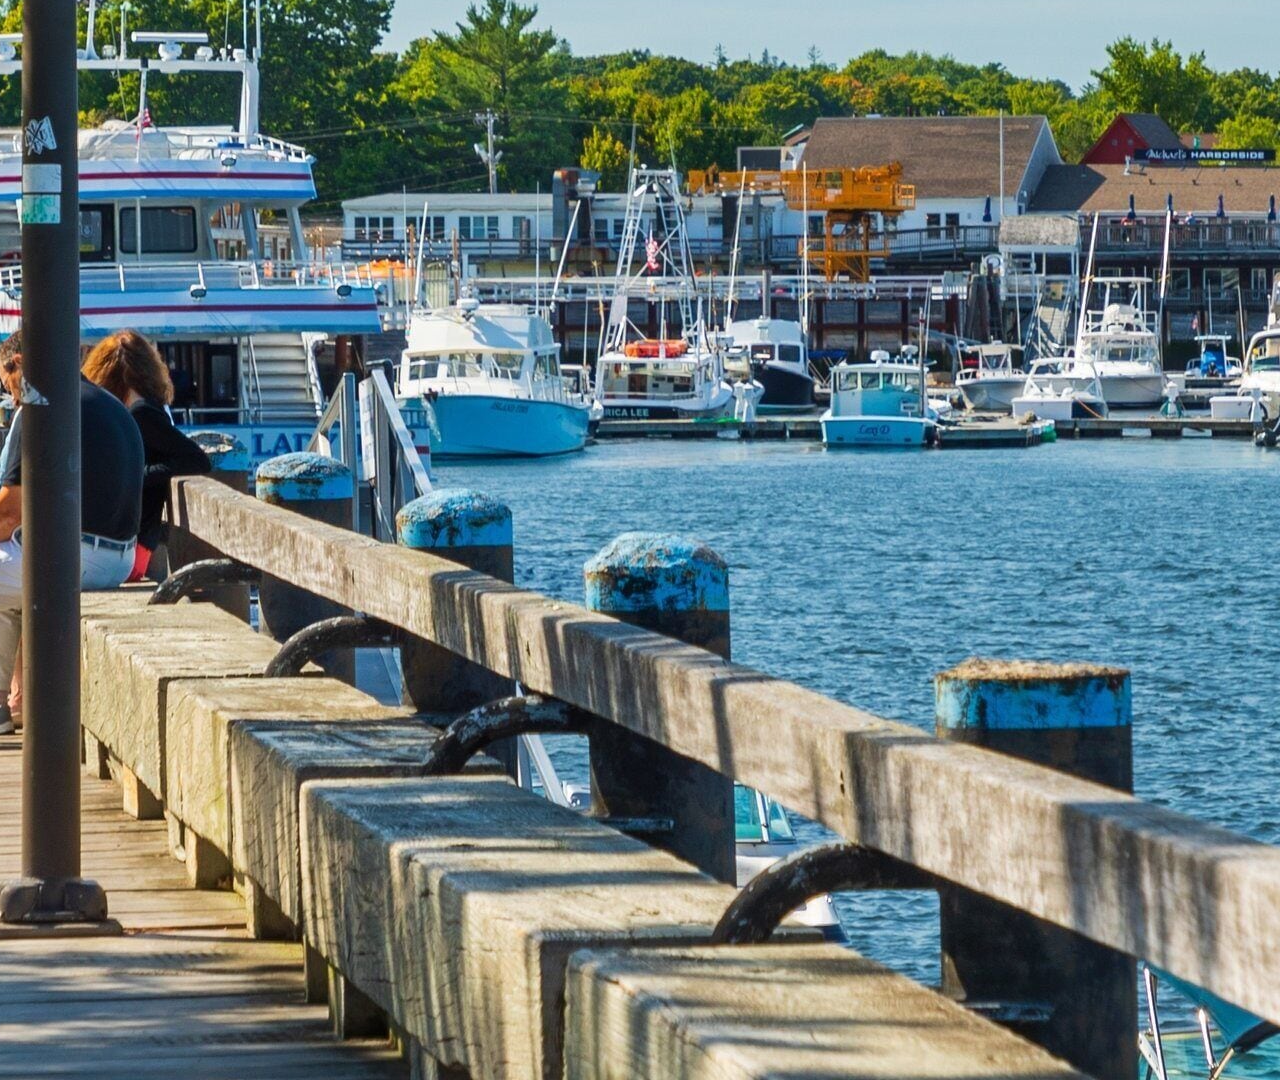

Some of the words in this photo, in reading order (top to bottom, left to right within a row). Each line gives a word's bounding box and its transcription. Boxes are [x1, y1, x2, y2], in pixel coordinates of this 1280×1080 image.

[1146, 149, 1186, 160] Michael's
[1191, 151, 1265, 159] HARBORSIDE
[604, 408, 629, 417] RICA
[630, 408, 649, 417] LEE
[252, 432, 338, 457] LAD
